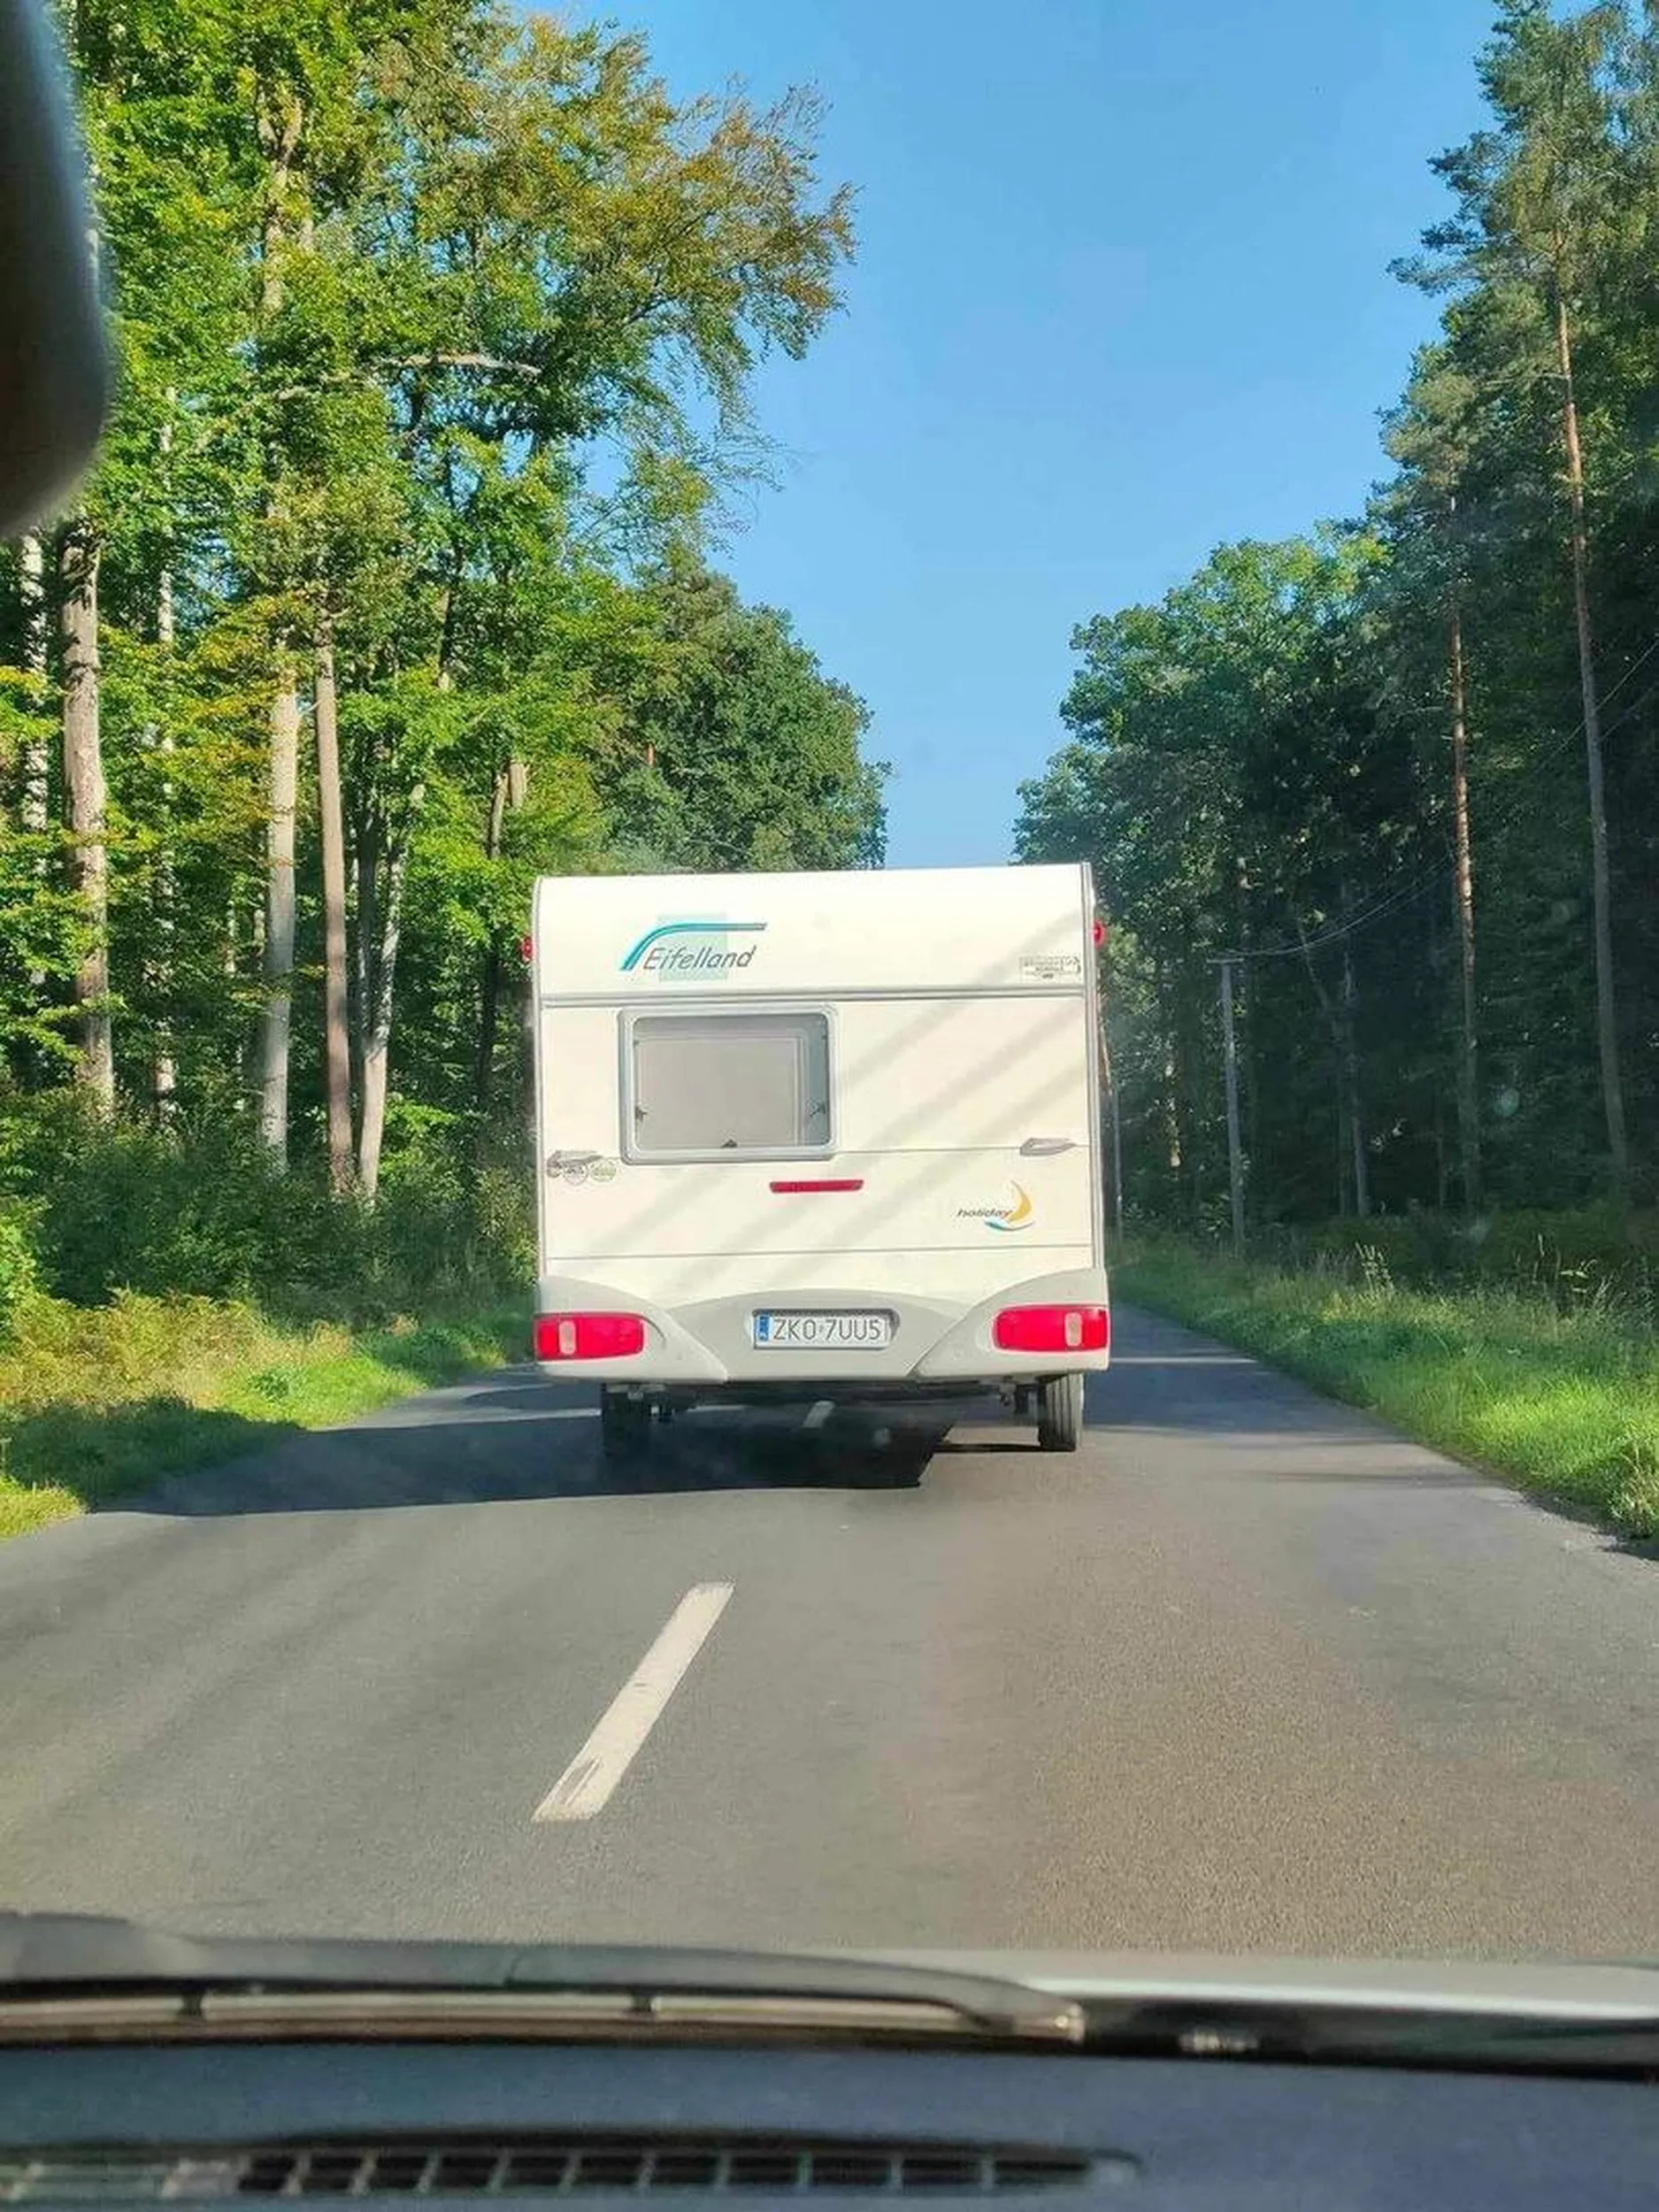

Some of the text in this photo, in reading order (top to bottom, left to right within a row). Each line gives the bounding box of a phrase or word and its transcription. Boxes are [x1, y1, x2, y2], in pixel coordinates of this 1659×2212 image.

[642, 945, 757, 971] Eifelland
[772, 1318, 881, 1341] ZKO 7UU5
